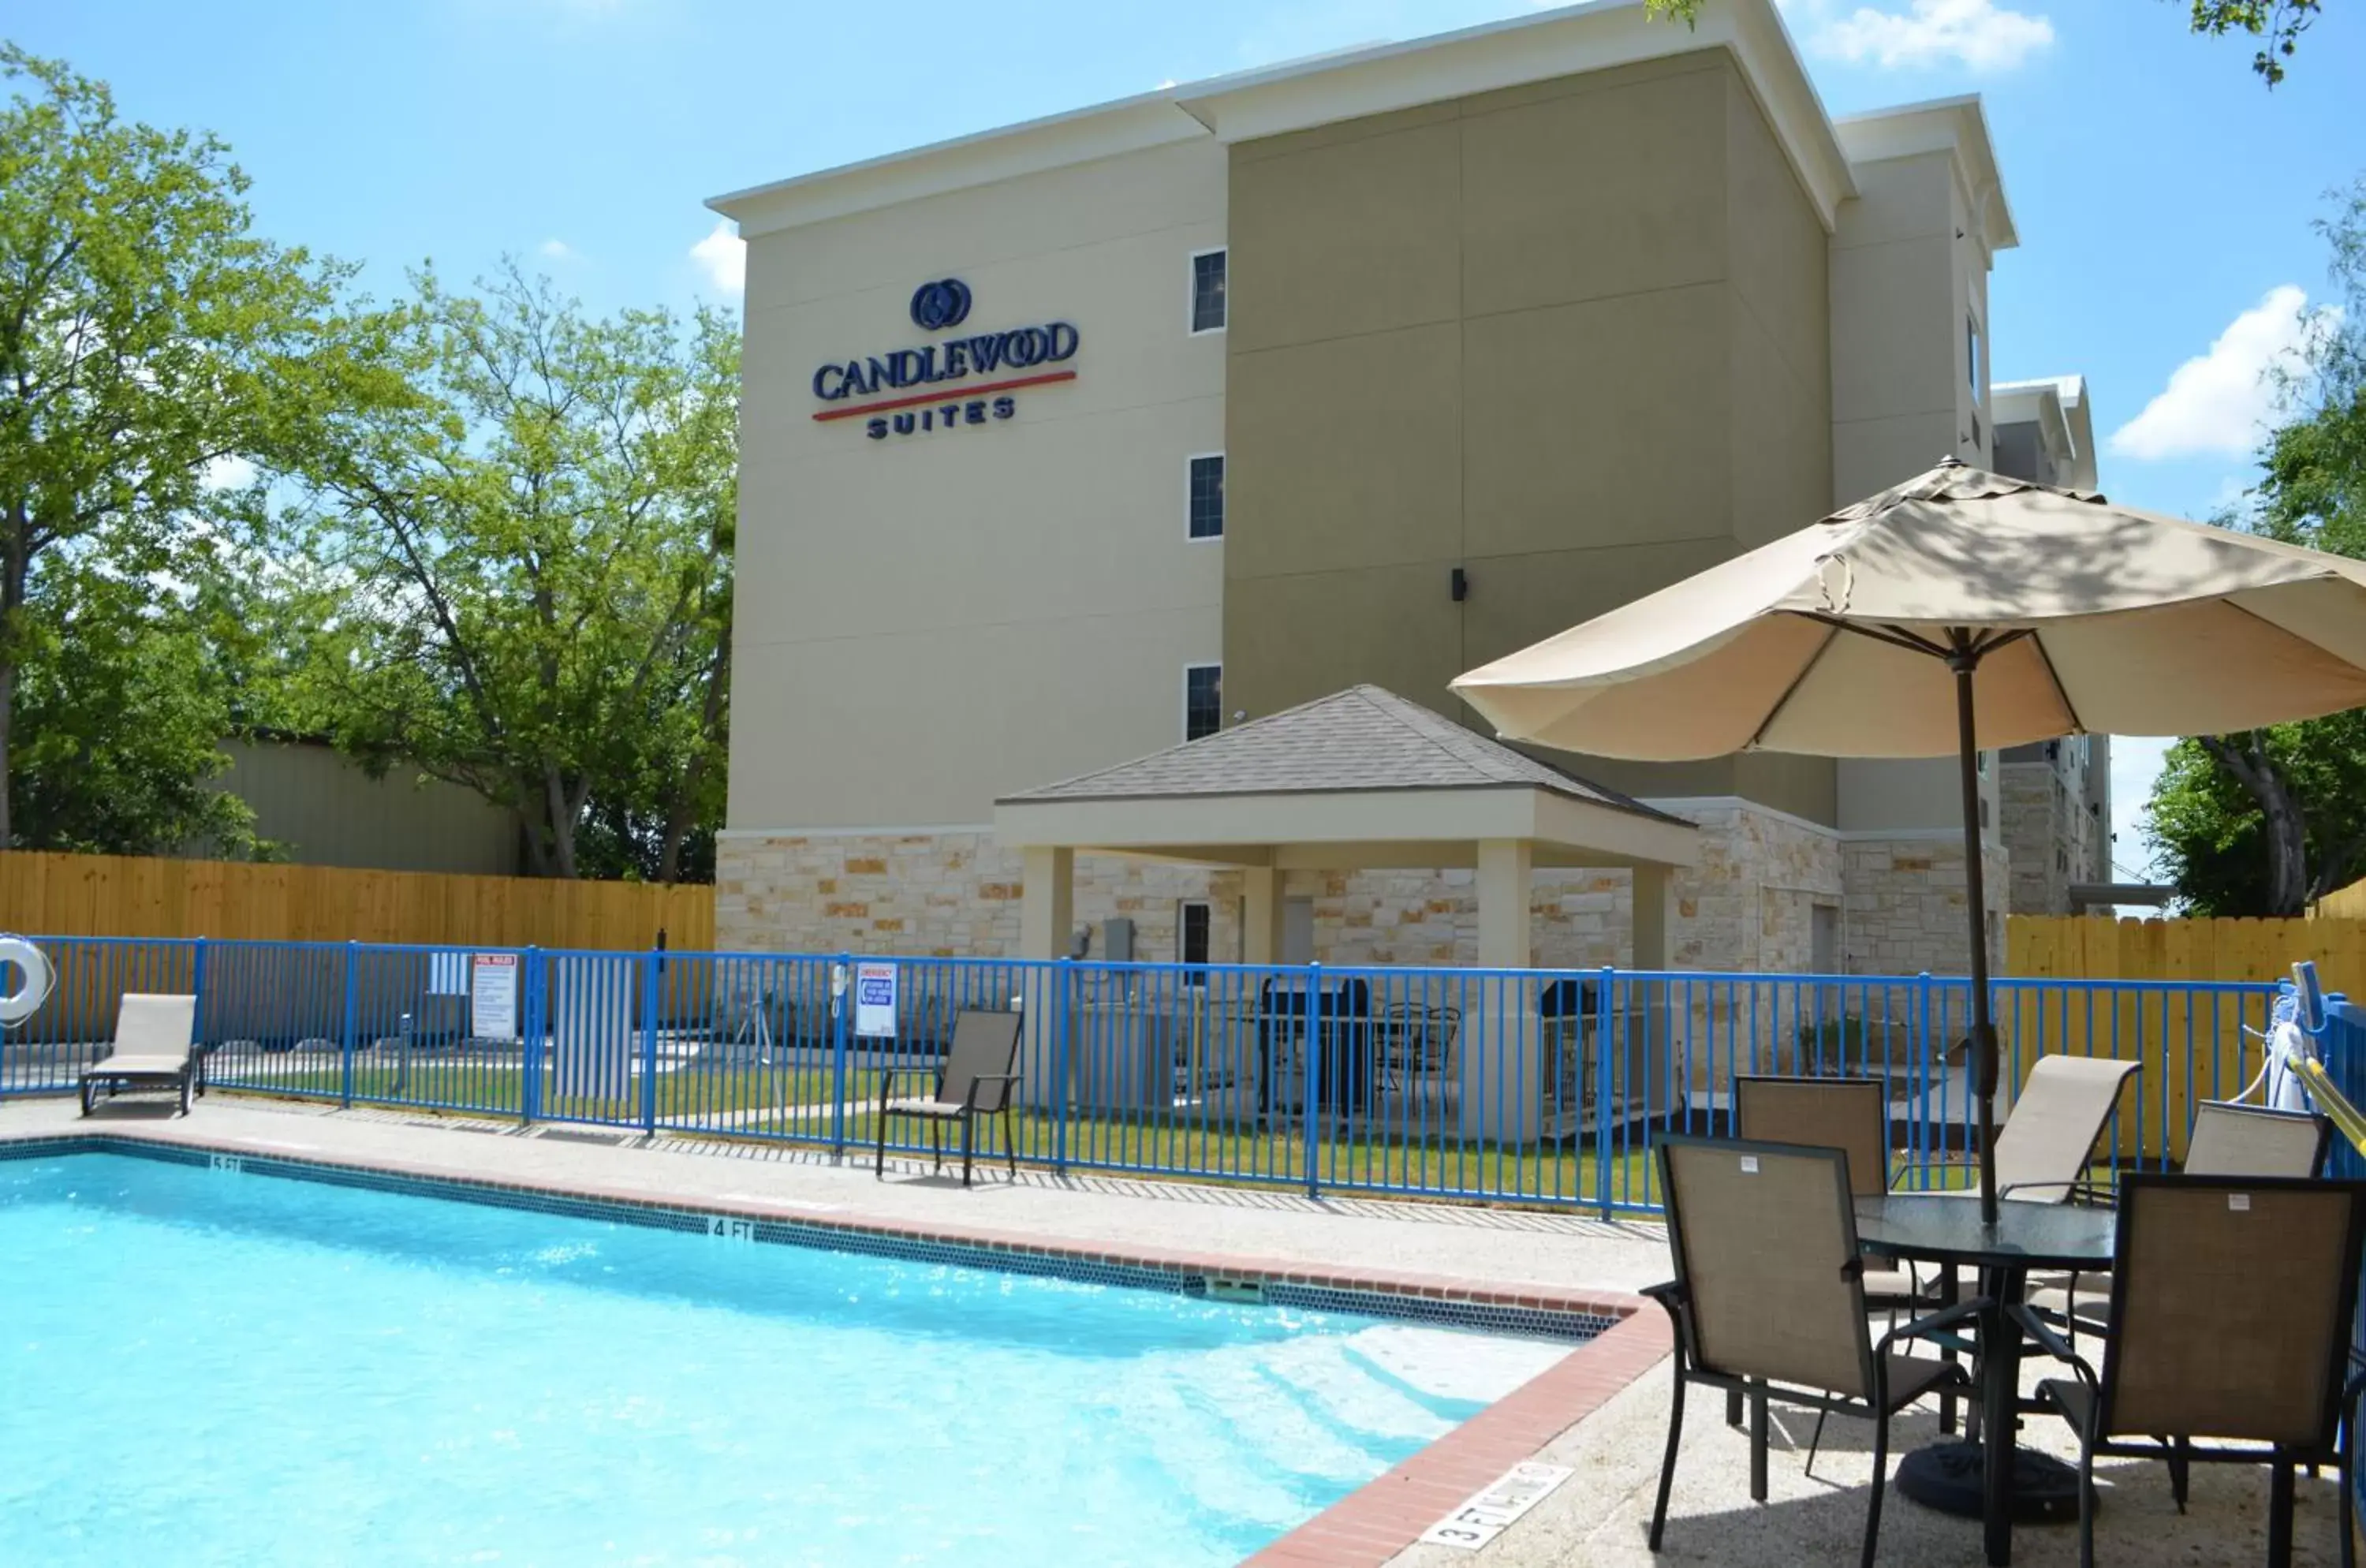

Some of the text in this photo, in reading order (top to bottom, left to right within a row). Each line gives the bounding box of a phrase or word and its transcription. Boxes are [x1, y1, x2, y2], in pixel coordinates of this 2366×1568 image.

[812, 323, 1079, 401] CANDLEWOOD
[867, 397, 1015, 439] SUITES
[714, 1219, 751, 1241] 4 FT
[1438, 1528, 1481, 1542] 3
